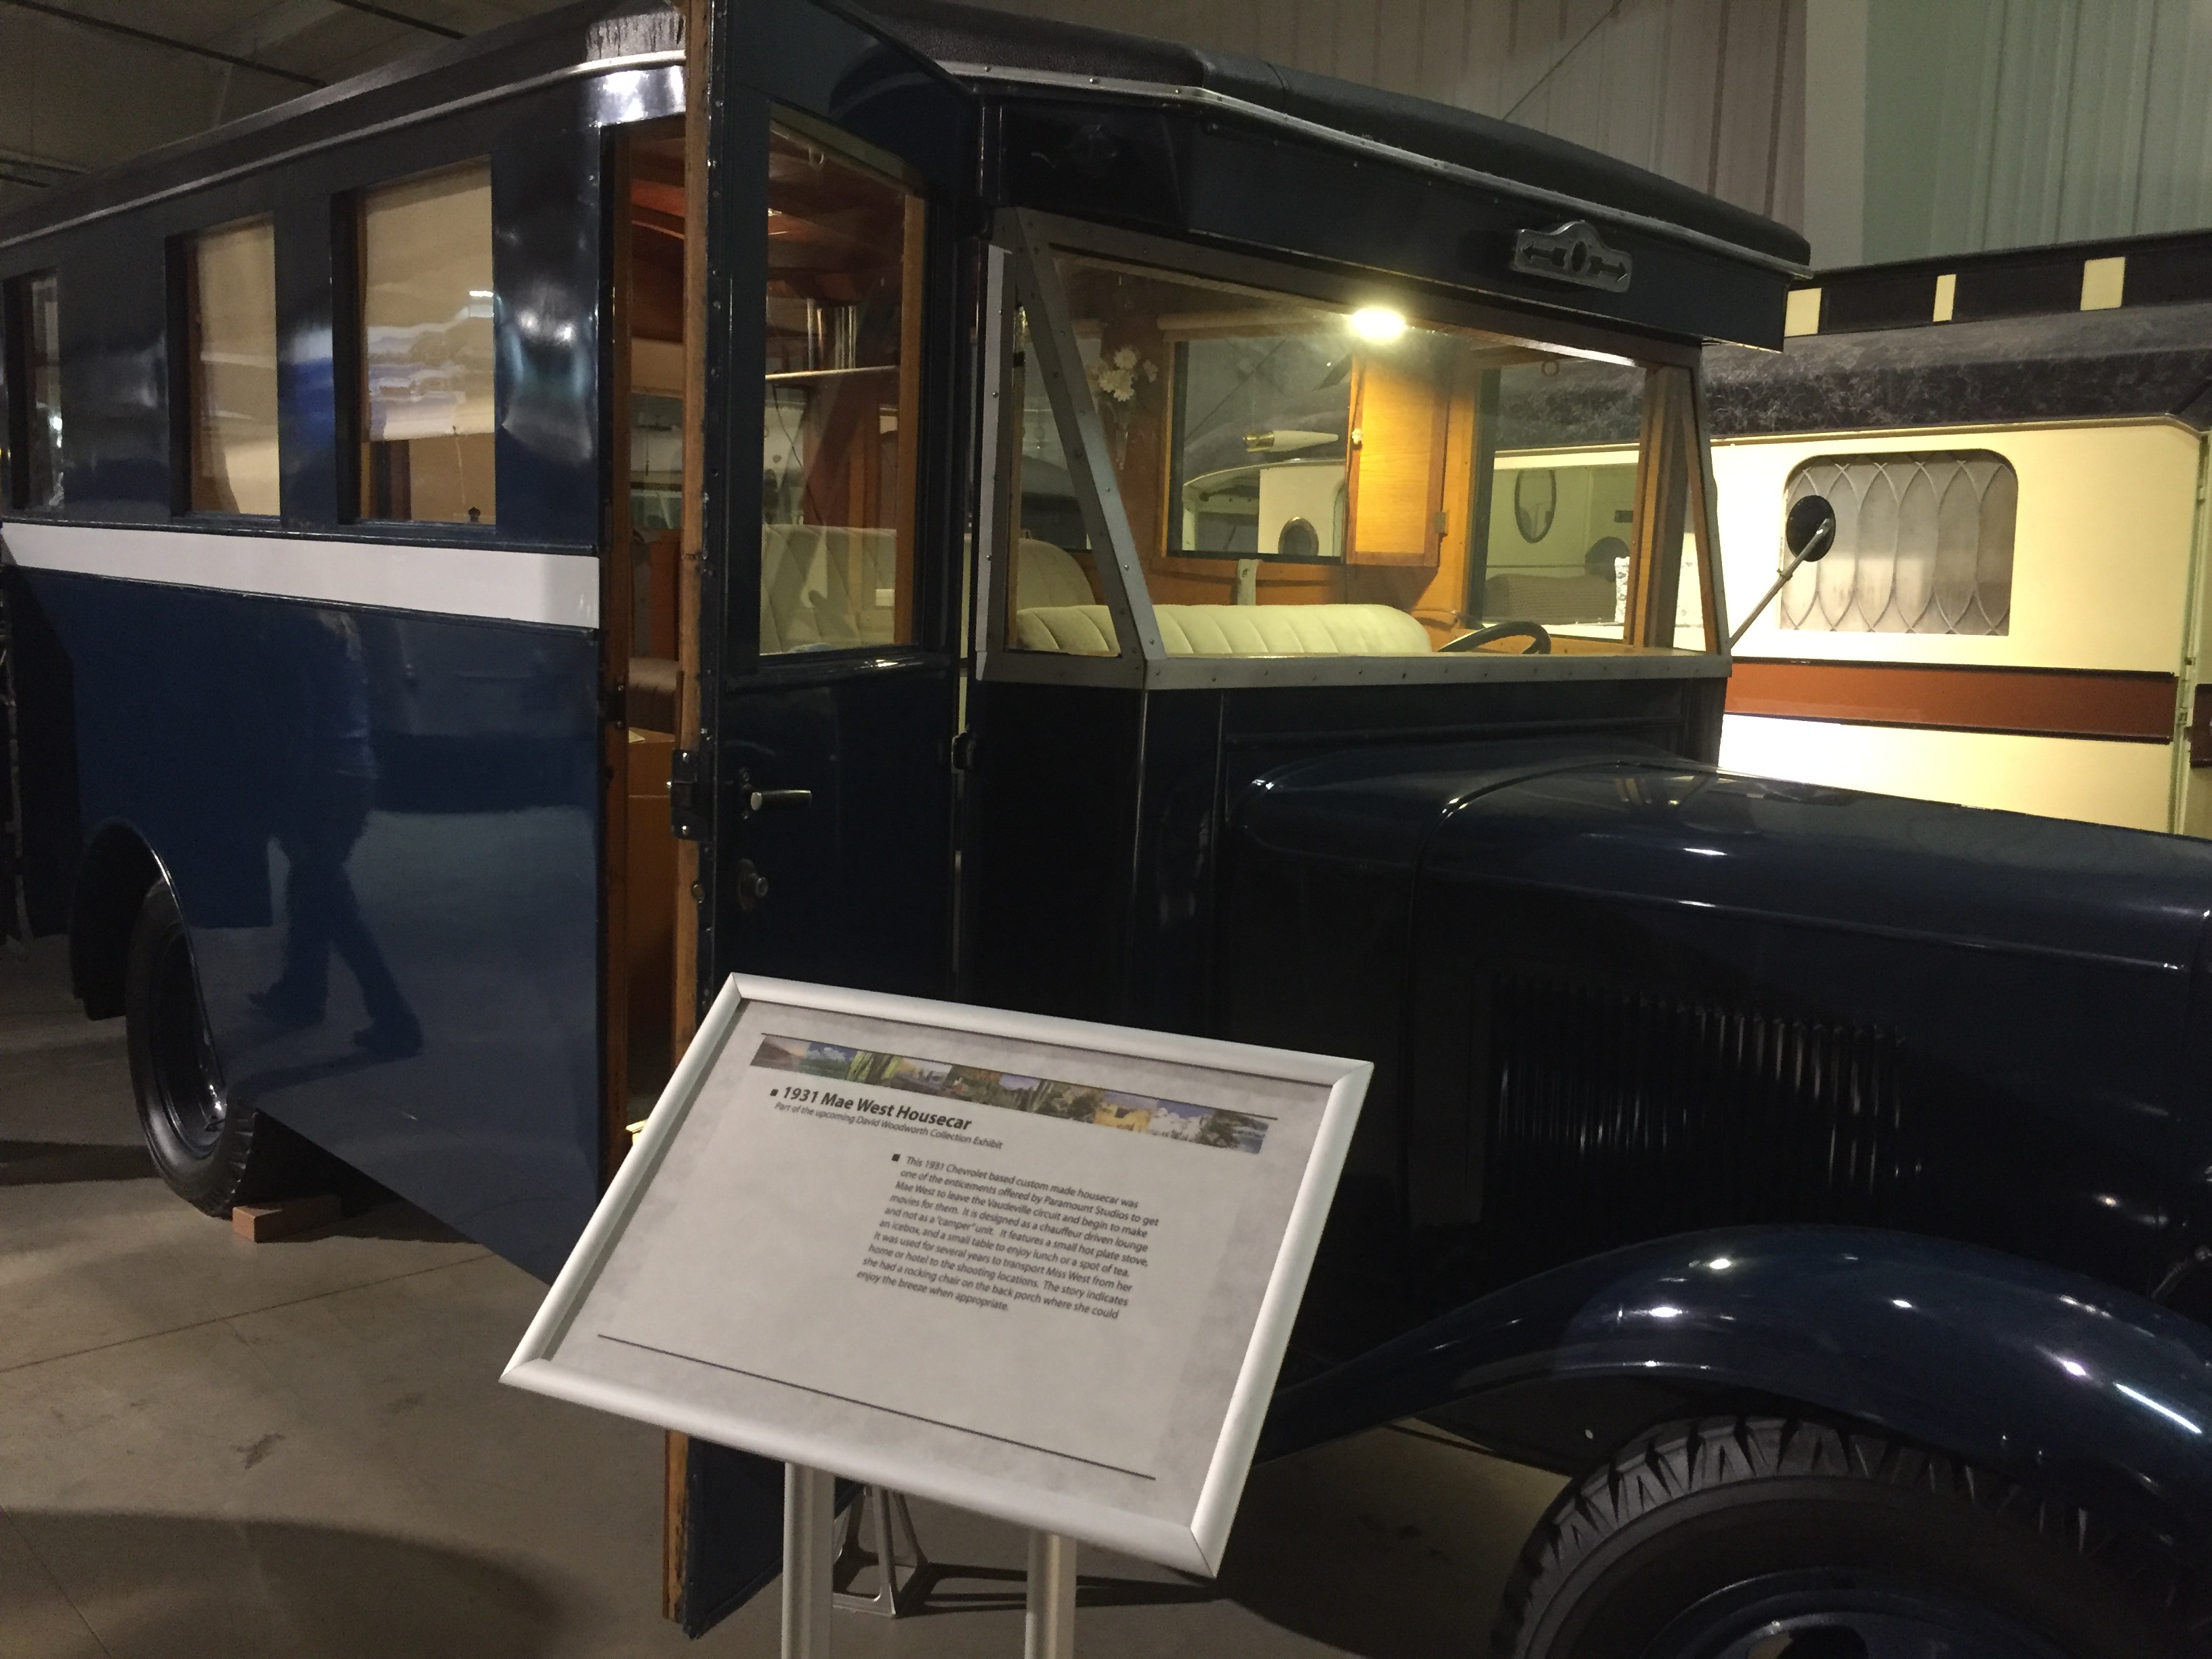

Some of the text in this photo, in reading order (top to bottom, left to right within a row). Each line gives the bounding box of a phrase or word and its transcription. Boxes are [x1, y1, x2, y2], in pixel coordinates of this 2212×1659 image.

[775, 1102, 1003, 1149] Part of the upcoming David Woodworth Collection Exhibit
[783, 1086, 972, 1130] 1931 Mae West Housecar
[895, 1181, 1147, 1237] Mae West to leave the Vaudeville circuit and begin to make
[901, 1170, 1159, 1227] one of the enticements offered by Paramount Studios to get
[907, 1156, 1139, 1208] This 1931 Chevrolet based custom made housecar was
[884, 1207, 901, 1217] and
[903, 1210, 917, 1221] not
[1000, 1229, 1008, 1237] It
[1008, 1231, 1044, 1245] features
[1053, 1240, 1078, 1252] small
[1078, 1244, 1094, 1254] hot
[1095, 1249, 1120, 1261] plate
[1122, 1254, 1148, 1267] stove,
[890, 1195, 920, 1207] movies
[922, 1200, 934, 1208] for
[935, 1203, 959, 1214] them.
[962, 1207, 969, 1216] It
[970, 1209, 977, 1218] is
[979, 1212, 1020, 1227] designed
[1021, 1220, 1030, 1229] as
[1040, 1224, 1082, 1238] chauffeur
[1084, 1231, 1113, 1244] driven
[1115, 1237, 1148, 1252] lounge
[868, 1244, 893, 1256] home
[905, 1251, 928, 1263] hotel
[930, 1257, 939, 1266] to
[941, 1259, 956, 1270] the
[956, 1263, 996, 1280] shooting
[997, 1271, 1039, 1288] locations.
[1044, 1280, 1060, 1292] The
[1061, 1286, 1085, 1298] story
[1086, 1290, 1129, 1307] indicates
[874, 1231, 1133, 1292] It was used for several years to transport Miss West from her
[922, 1229, 939, 1239] and
[947, 1234, 970, 1245] small
[972, 1238, 994, 1250] table
[996, 1243, 1005, 1251] to
[1007, 1246, 1031, 1258] enjoy
[1033, 1249, 1058, 1263] lunch
[1060, 1256, 1071, 1265] or
[1079, 1260, 1100, 1271] spot
[1101, 1264, 1113, 1273] of
[1113, 1267, 1129, 1277] tea.
[857, 1270, 1008, 1311] enjoy the breeze when appropriate.
[863, 1257, 878, 1267] she
[880, 1261, 897, 1271] had
[904, 1267, 937, 1282] rocking
[938, 1274, 961, 1285] chair
[975, 1281, 990, 1292] the
[992, 1284, 1013, 1297] back
[1014, 1290, 1042, 1303] porch
[1043, 1296, 1072, 1309] where
[1073, 1303, 1090, 1313] she
[1092, 1307, 1120, 1319] could
